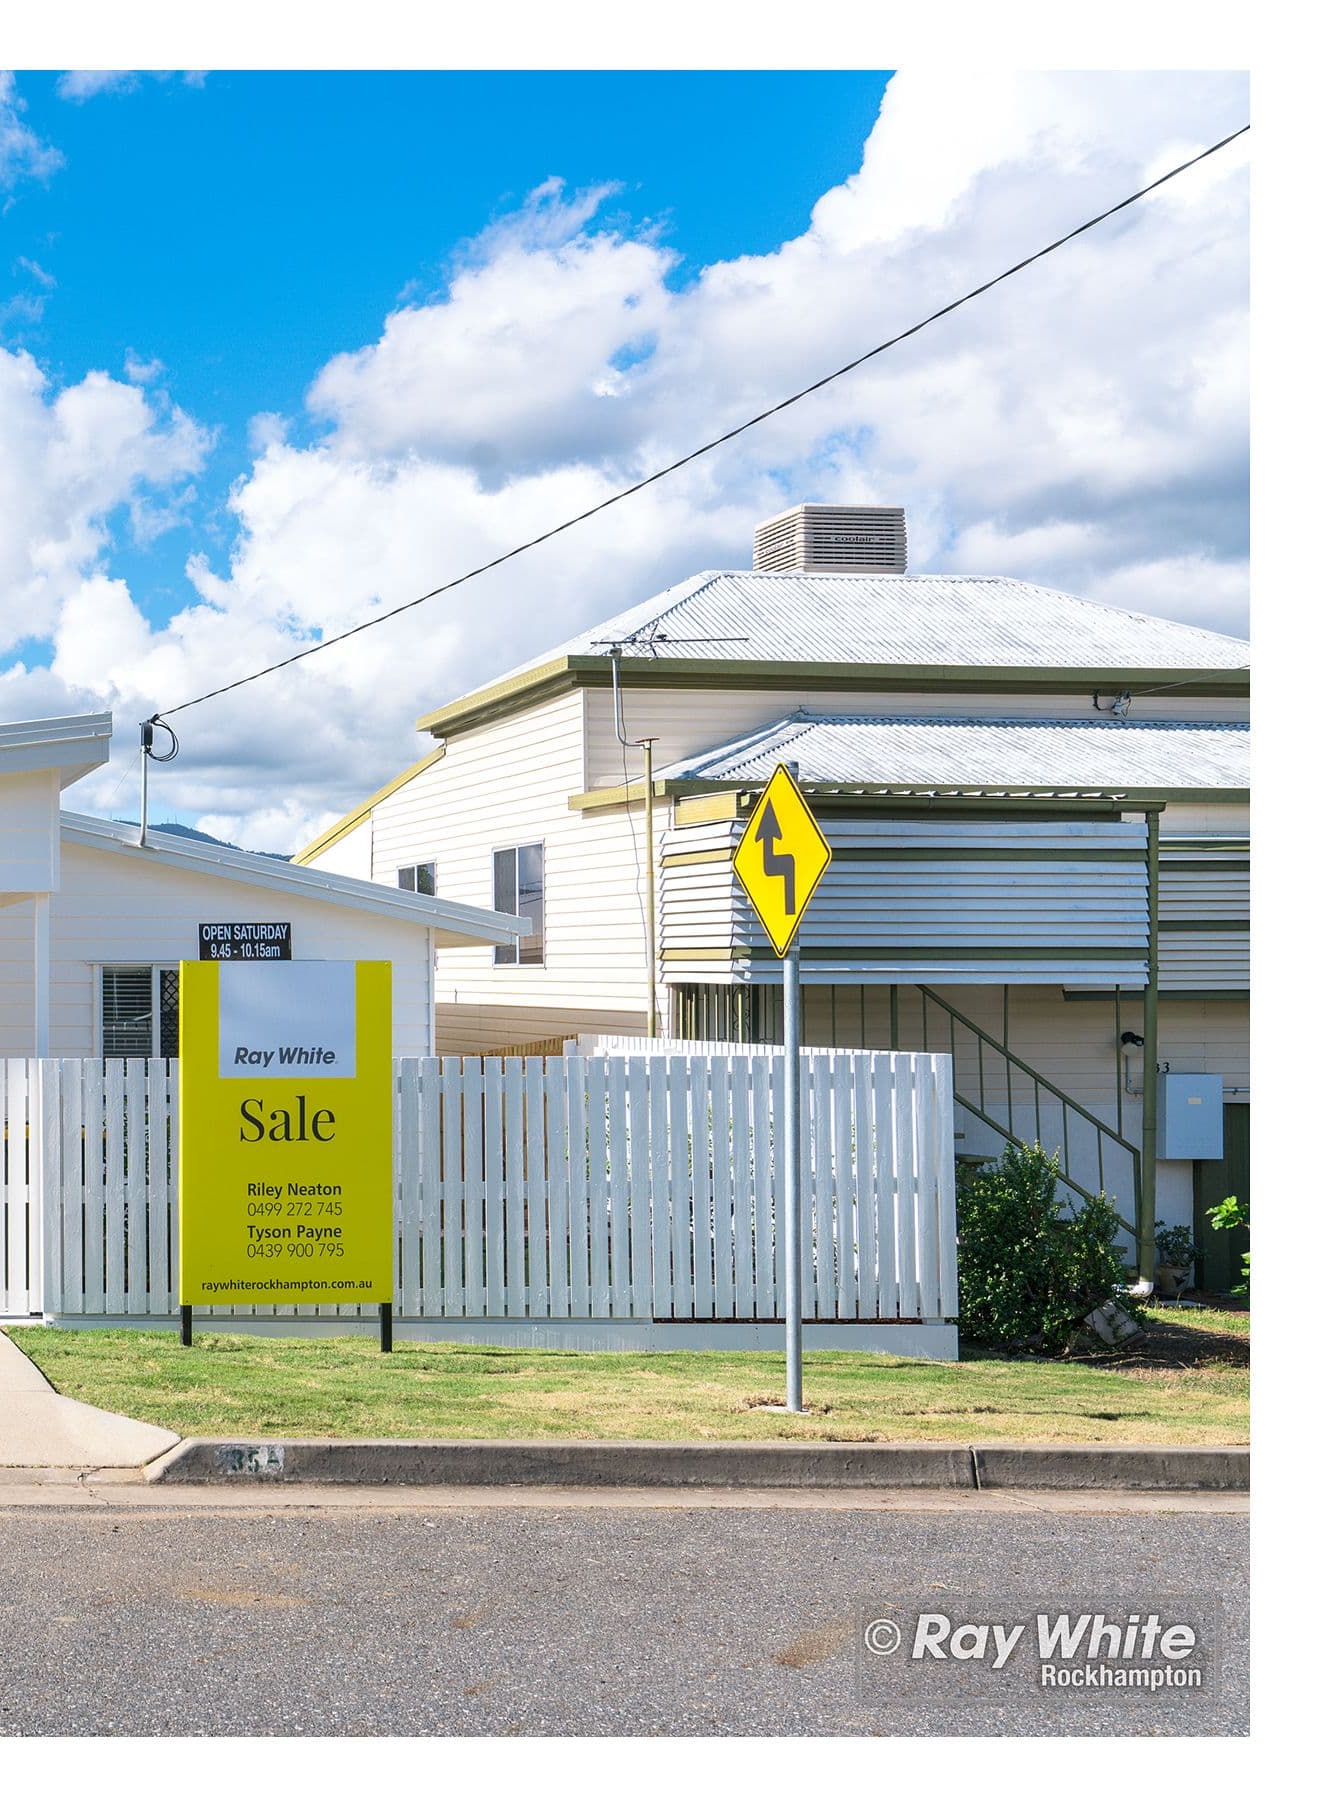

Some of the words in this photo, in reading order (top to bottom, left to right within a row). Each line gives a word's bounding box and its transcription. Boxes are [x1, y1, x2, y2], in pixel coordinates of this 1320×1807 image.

[202, 925, 231, 941] OPEN
[233, 924, 288, 940] SATURDAY
[210, 943, 231, 958] 9.45
[240, 942, 281, 958] 10.15am
[234, 1047, 275, 1068] Ray
[279, 1047, 336, 1065] White
[240, 1095, 336, 1142] Sale
[247, 1183, 283, 1200] Riley
[287, 1183, 342, 1196] Neaton
[247, 1202, 283, 1217] 0499
[286, 1202, 312, 1217] 272
[317, 1202, 343, 1216] 745
[247, 1225, 291, 1242] Tyson
[297, 1225, 342, 1241] Payne
[247, 1243, 283, 1258] 0439
[287, 1243, 314, 1258] 900
[318, 1243, 345, 1257] 795
[201, 1279, 373, 1293] raywhiterockhampton.com.au
